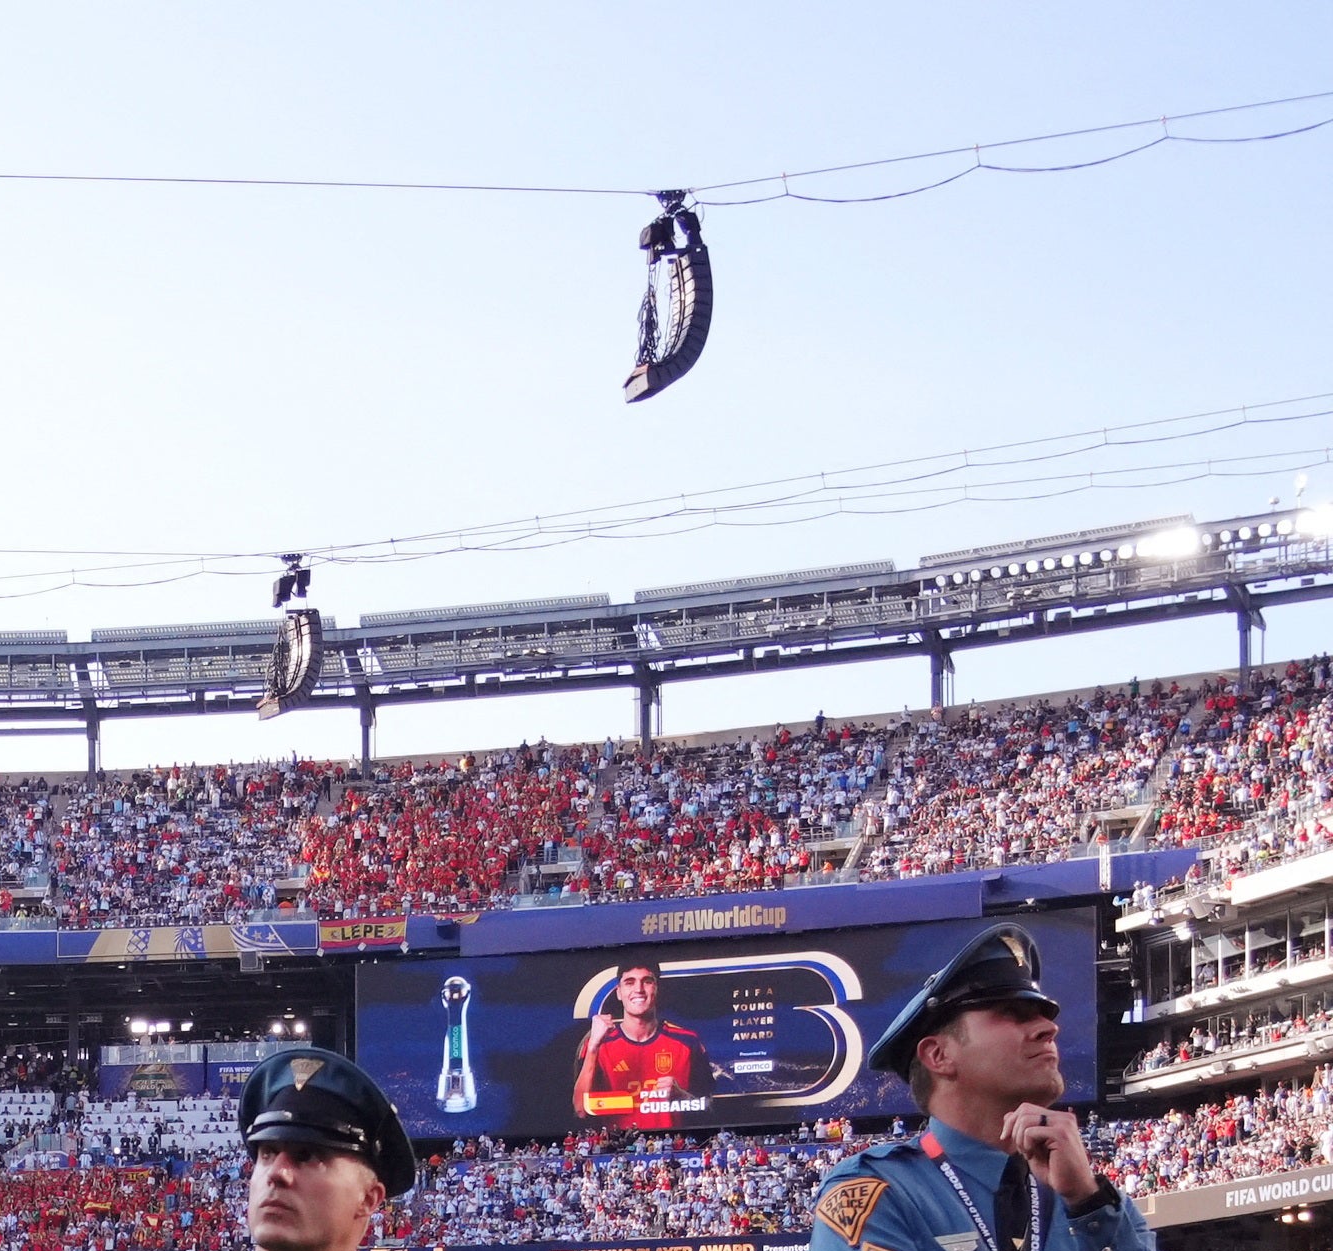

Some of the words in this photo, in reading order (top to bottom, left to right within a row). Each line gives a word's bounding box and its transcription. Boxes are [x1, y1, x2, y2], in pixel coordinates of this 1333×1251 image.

[641, 905, 786, 935] #FIFAWorldCup
[341, 924, 384, 941] LEPE
[733, 988, 773, 998] FIFA
[733, 1002, 773, 1012] YOUNG
[733, 1016, 773, 1027] PLAYER
[733, 1031, 773, 1041] AWARD
[736, 1063, 770, 1071] aramco
[219, 1073, 250, 1083] THE
[640, 1090, 667, 1099] PAU
[939, 1162, 964, 1191] 2026
[825, 1184, 870, 1212] STATE
[958, 1189, 974, 1207] CUP
[1225, 1188, 1257, 1208] FIFA
[1258, 1178, 1310, 1202] WORLD
[1311, 1173, 1333, 1193] CU
[830, 1197, 865, 1218] POLICE
[1030, 1187, 1040, 1216] WORLD
[968, 1206, 991, 1238] WORLD
[1031, 1216, 1040, 1234] CUP
